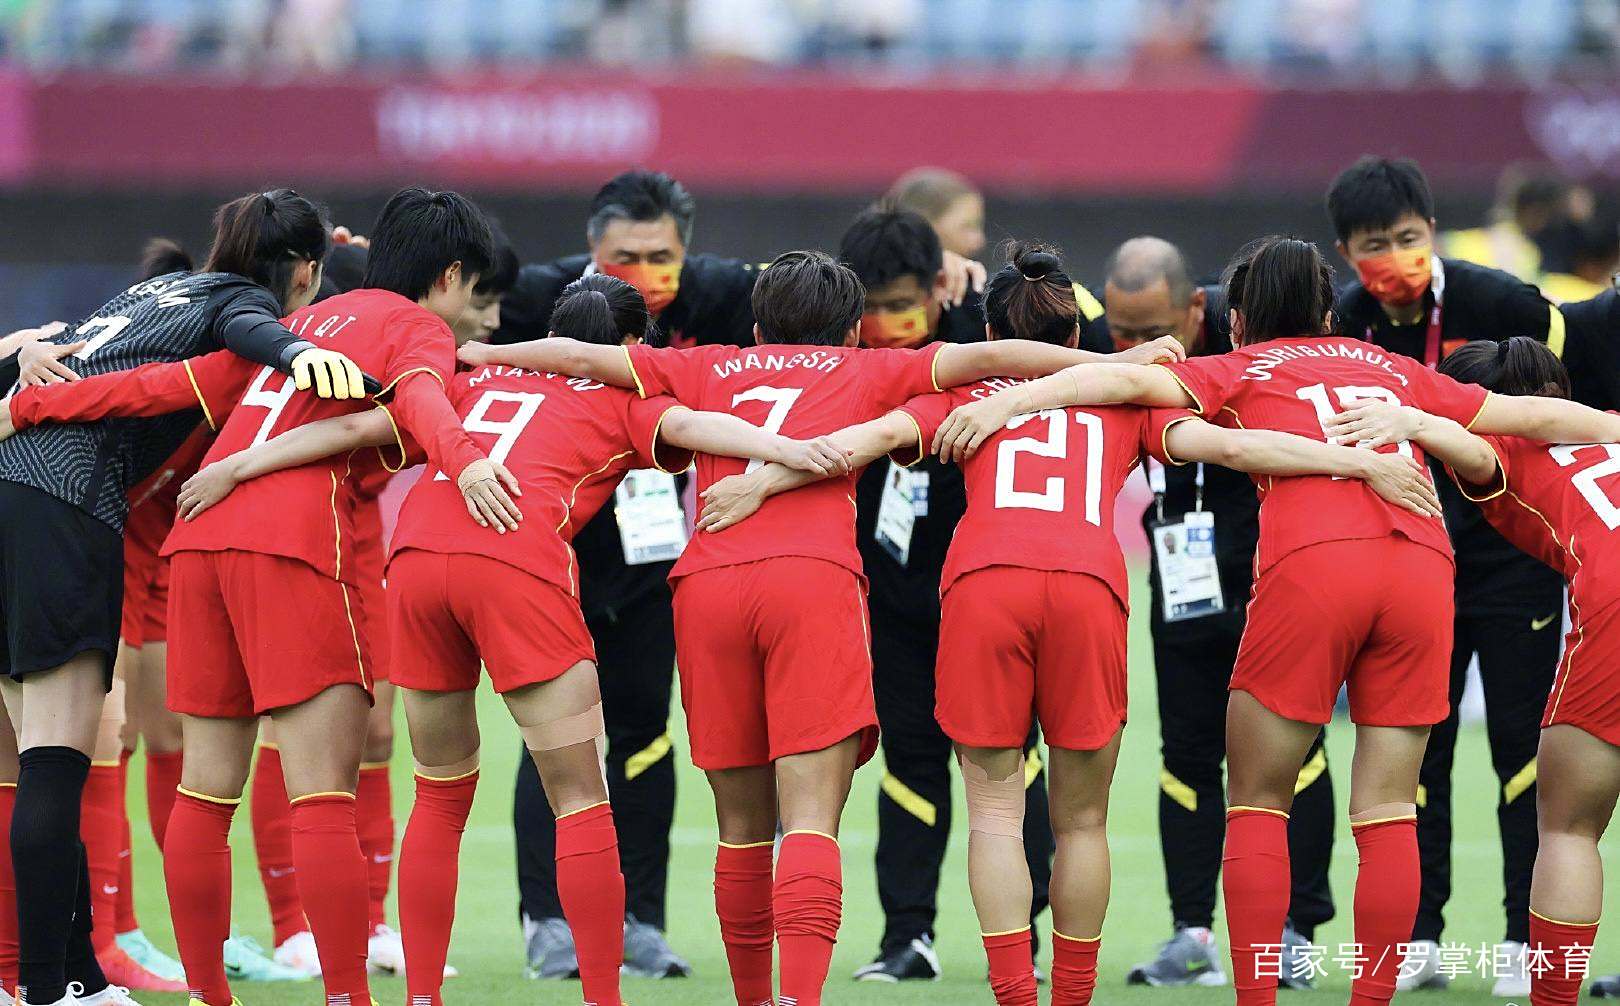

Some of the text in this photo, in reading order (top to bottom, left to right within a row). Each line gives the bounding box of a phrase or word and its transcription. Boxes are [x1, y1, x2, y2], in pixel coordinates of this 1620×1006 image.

[240, 364, 298, 448] 4
[731, 385, 804, 476] 7
[994, 408, 1105, 527] 21
